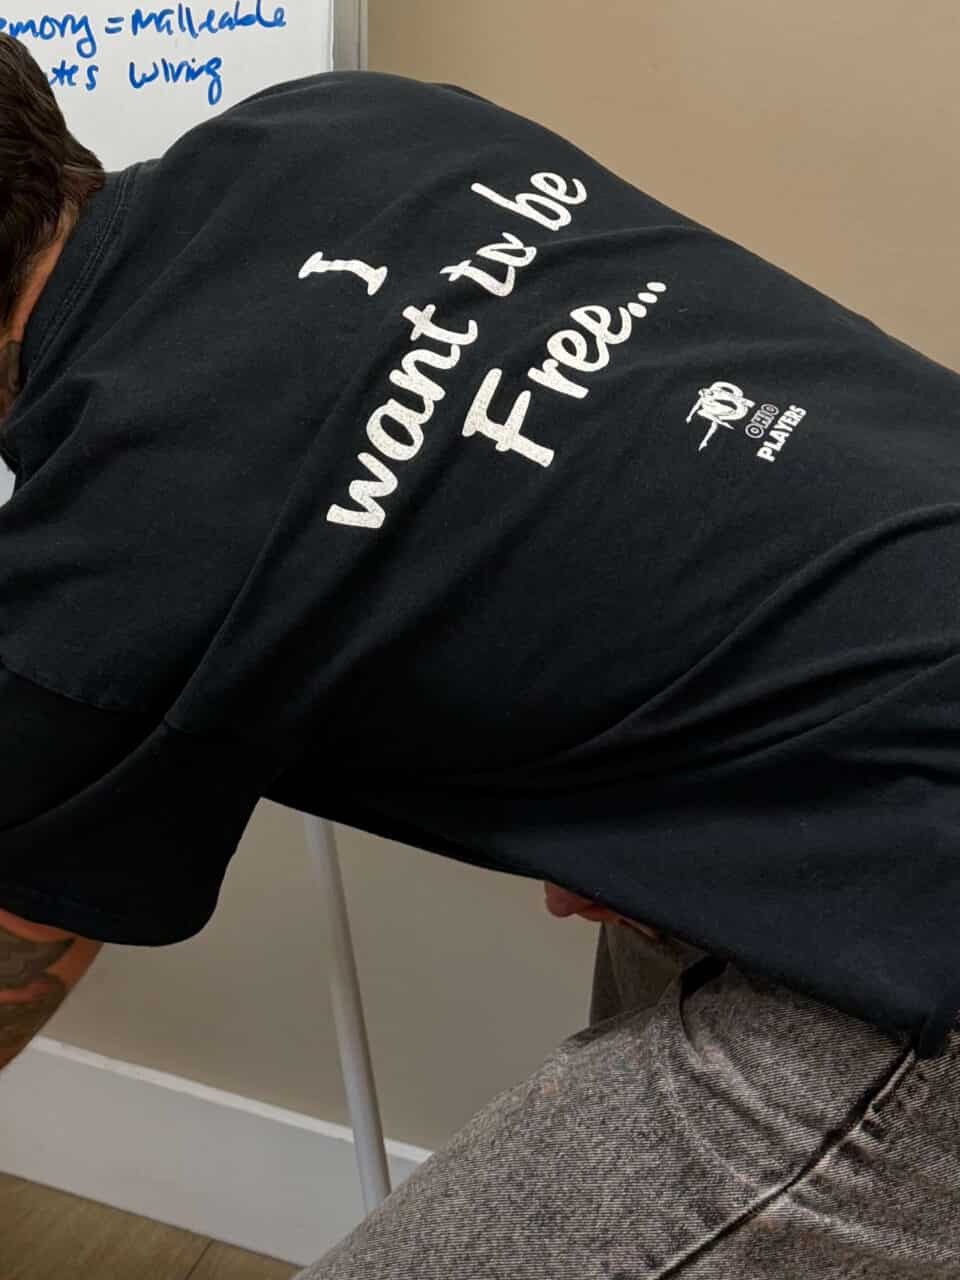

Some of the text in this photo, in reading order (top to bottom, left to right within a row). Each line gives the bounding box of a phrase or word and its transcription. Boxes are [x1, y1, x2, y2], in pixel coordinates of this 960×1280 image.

[128, 56, 223, 106] wiring
[298, 251, 387, 296] I
[326, 171, 587, 529] want to be
[757, 404, 807, 462] PLAYERS
